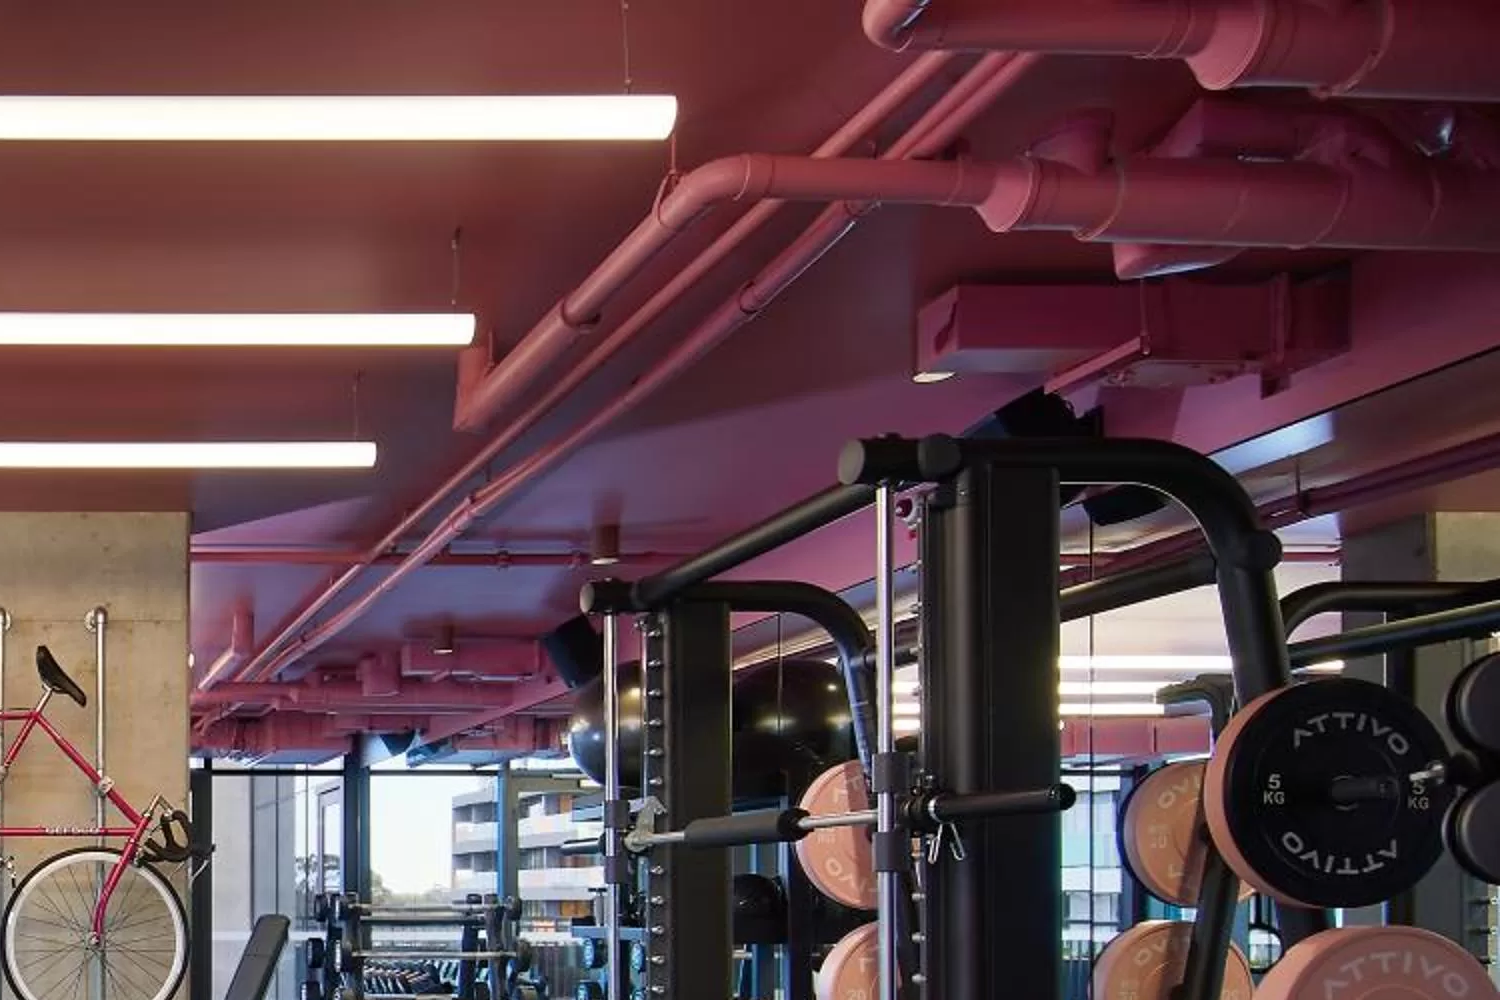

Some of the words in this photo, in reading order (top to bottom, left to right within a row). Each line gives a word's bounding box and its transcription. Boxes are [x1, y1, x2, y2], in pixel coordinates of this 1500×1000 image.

[1293, 711, 1410, 756] ATTIVO
[1268, 773, 1282, 790] 5
[1263, 791, 1286, 805] KG
[1407, 797, 1430, 810] KG
[1281, 830, 1398, 876] ATTIVO
